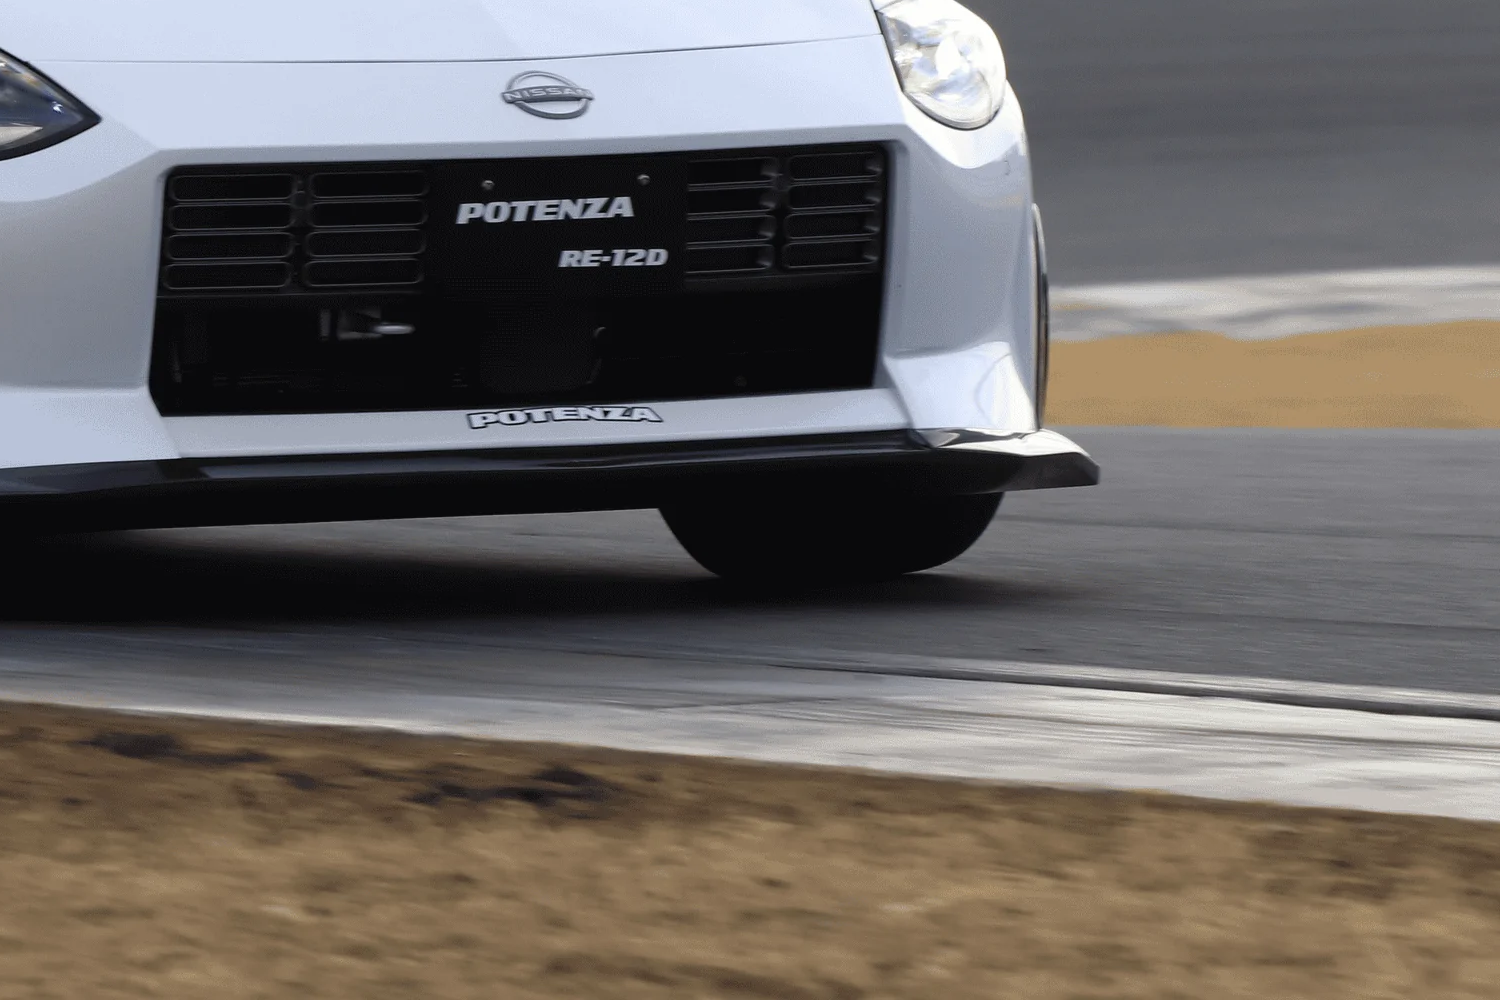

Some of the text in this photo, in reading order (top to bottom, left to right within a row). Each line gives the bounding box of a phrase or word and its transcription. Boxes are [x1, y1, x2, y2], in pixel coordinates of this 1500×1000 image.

[505, 87, 593, 101] NISSAN
[456, 196, 635, 224] POTENZA
[558, 248, 669, 268] RE-12D
[467, 406, 664, 429] POTENZA
